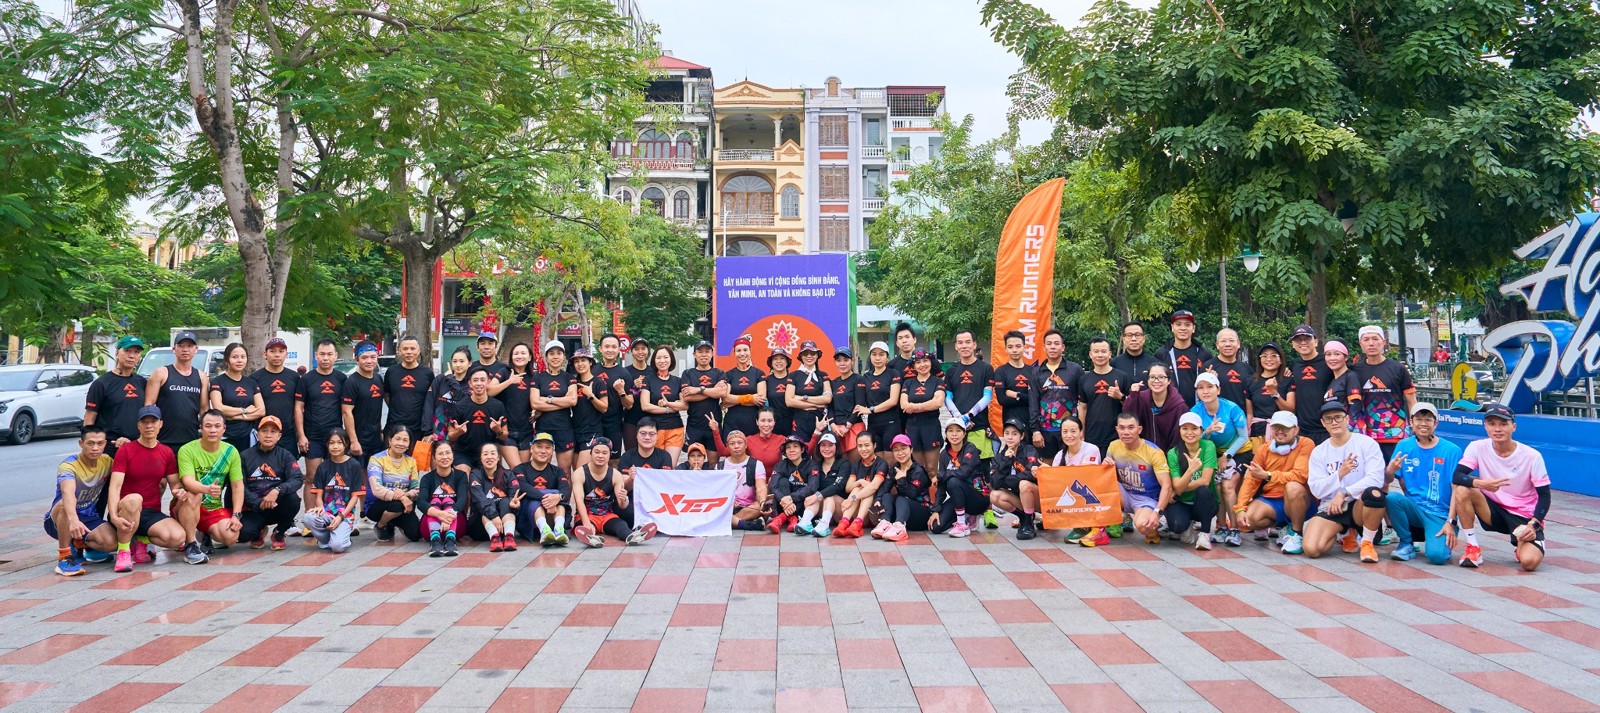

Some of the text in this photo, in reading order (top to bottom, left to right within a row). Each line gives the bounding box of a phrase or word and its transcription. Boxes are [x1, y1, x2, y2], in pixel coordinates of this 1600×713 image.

[735, 276, 751, 286] HÀNH
[751, 276, 768, 288] ĐỘNG
[768, 275, 774, 286] VÌ
[774, 275, 791, 287] CỘNG
[807, 274, 822, 285] BÌNH
[728, 286, 836, 299] VĂN MINH, AN TOÀN VÀ KHÔNG BẠO LỰC
[169, 384, 201, 394] GARMIN
[1445, 415, 1462, 425] Phong
[1461, 415, 1483, 426] Tourism
[646, 492, 728, 516] XTEP
